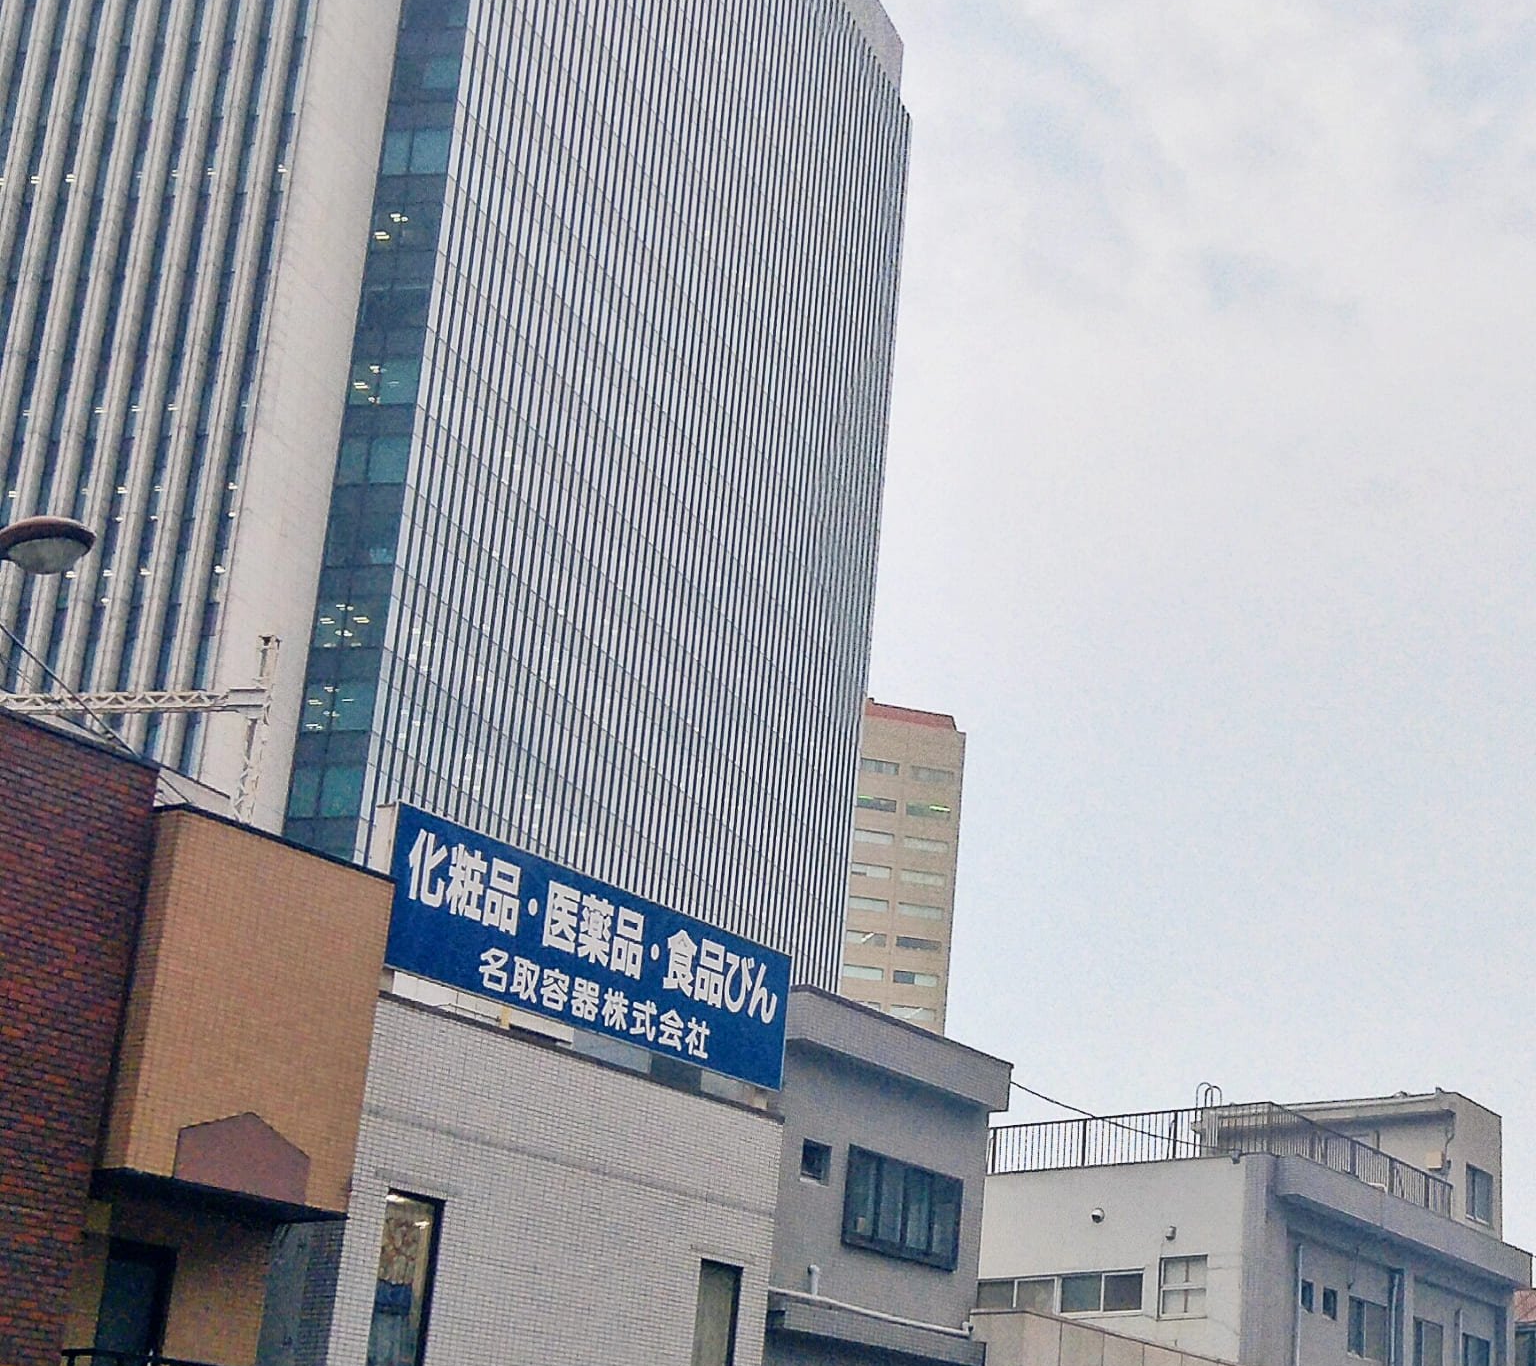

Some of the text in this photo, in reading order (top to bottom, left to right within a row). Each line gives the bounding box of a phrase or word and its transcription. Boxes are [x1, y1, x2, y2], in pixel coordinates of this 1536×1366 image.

[479, 948, 710, 1060] 名取容器株式会社
